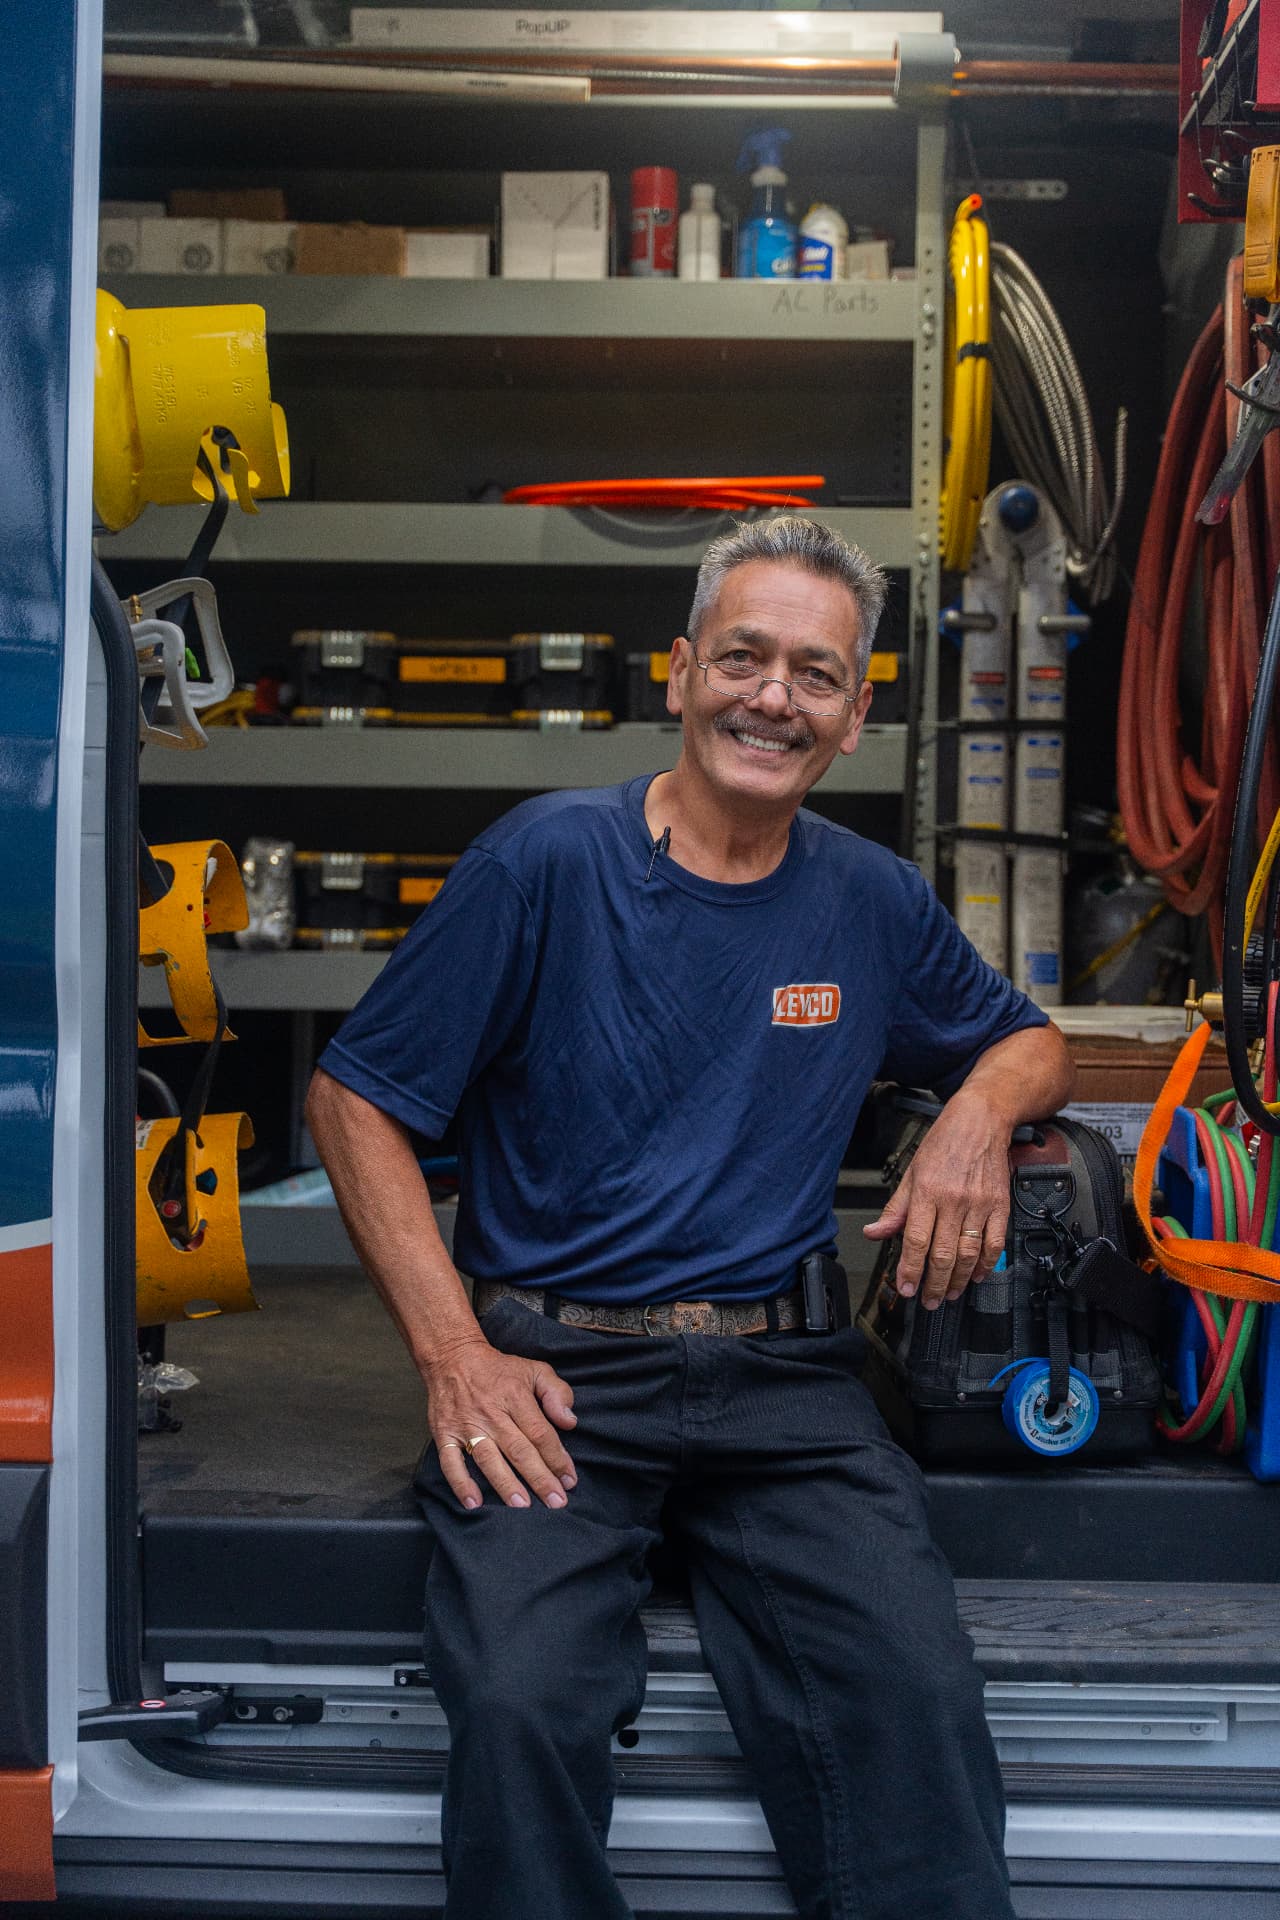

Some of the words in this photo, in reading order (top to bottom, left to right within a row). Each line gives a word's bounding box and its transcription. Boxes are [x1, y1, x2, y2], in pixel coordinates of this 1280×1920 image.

[772, 287, 809, 313] AC
[823, 286, 880, 313] Parts
[775, 992, 833, 1017] LEYCO
